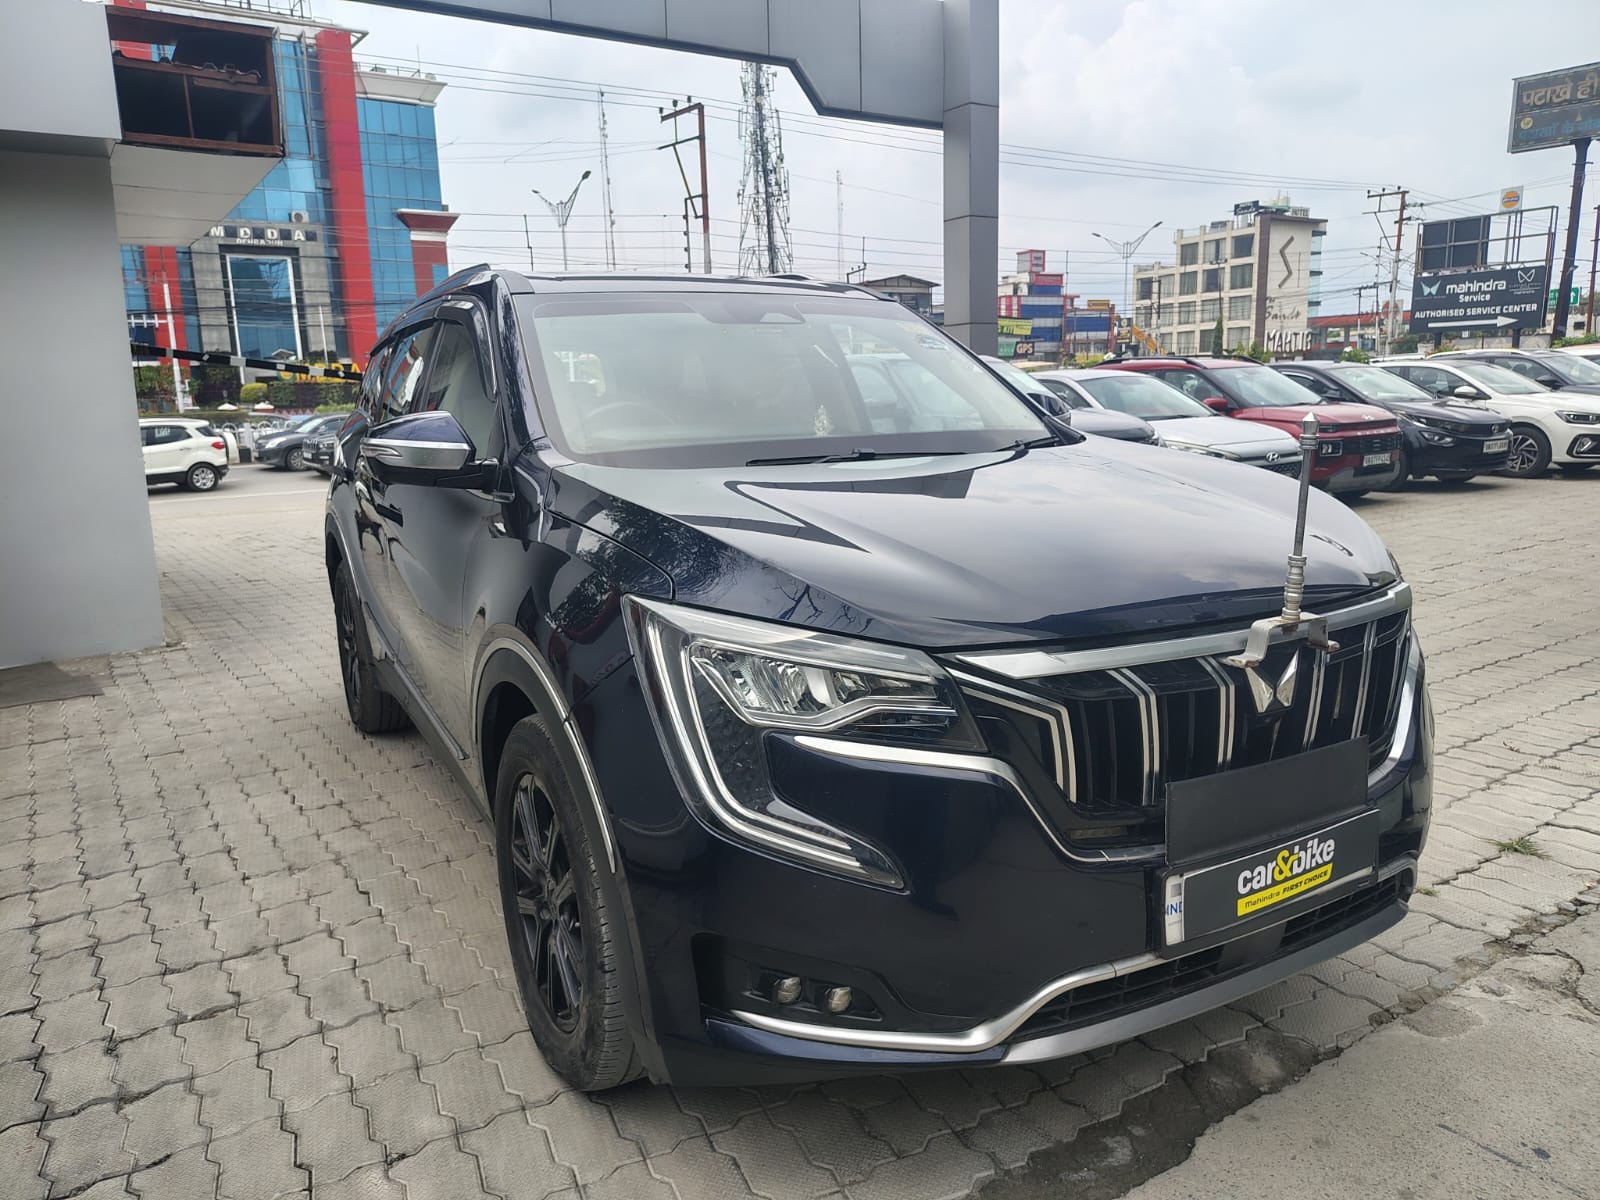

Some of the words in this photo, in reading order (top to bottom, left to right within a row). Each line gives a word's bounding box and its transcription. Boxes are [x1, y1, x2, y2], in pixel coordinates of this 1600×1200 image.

[210, 226, 305, 241] MDDA
[1459, 293, 1491, 303] Service
[1415, 309, 1464, 319] AUTHORISED
[1466, 306, 1501, 316] SERVICE
[1503, 303, 1538, 313] CENTER
[1016, 343, 1033, 354] GPS
[1237, 838, 1335, 895] car&bike
[1282, 882, 1303, 895] FIRST
[1303, 869, 1328, 886] CHOICE
